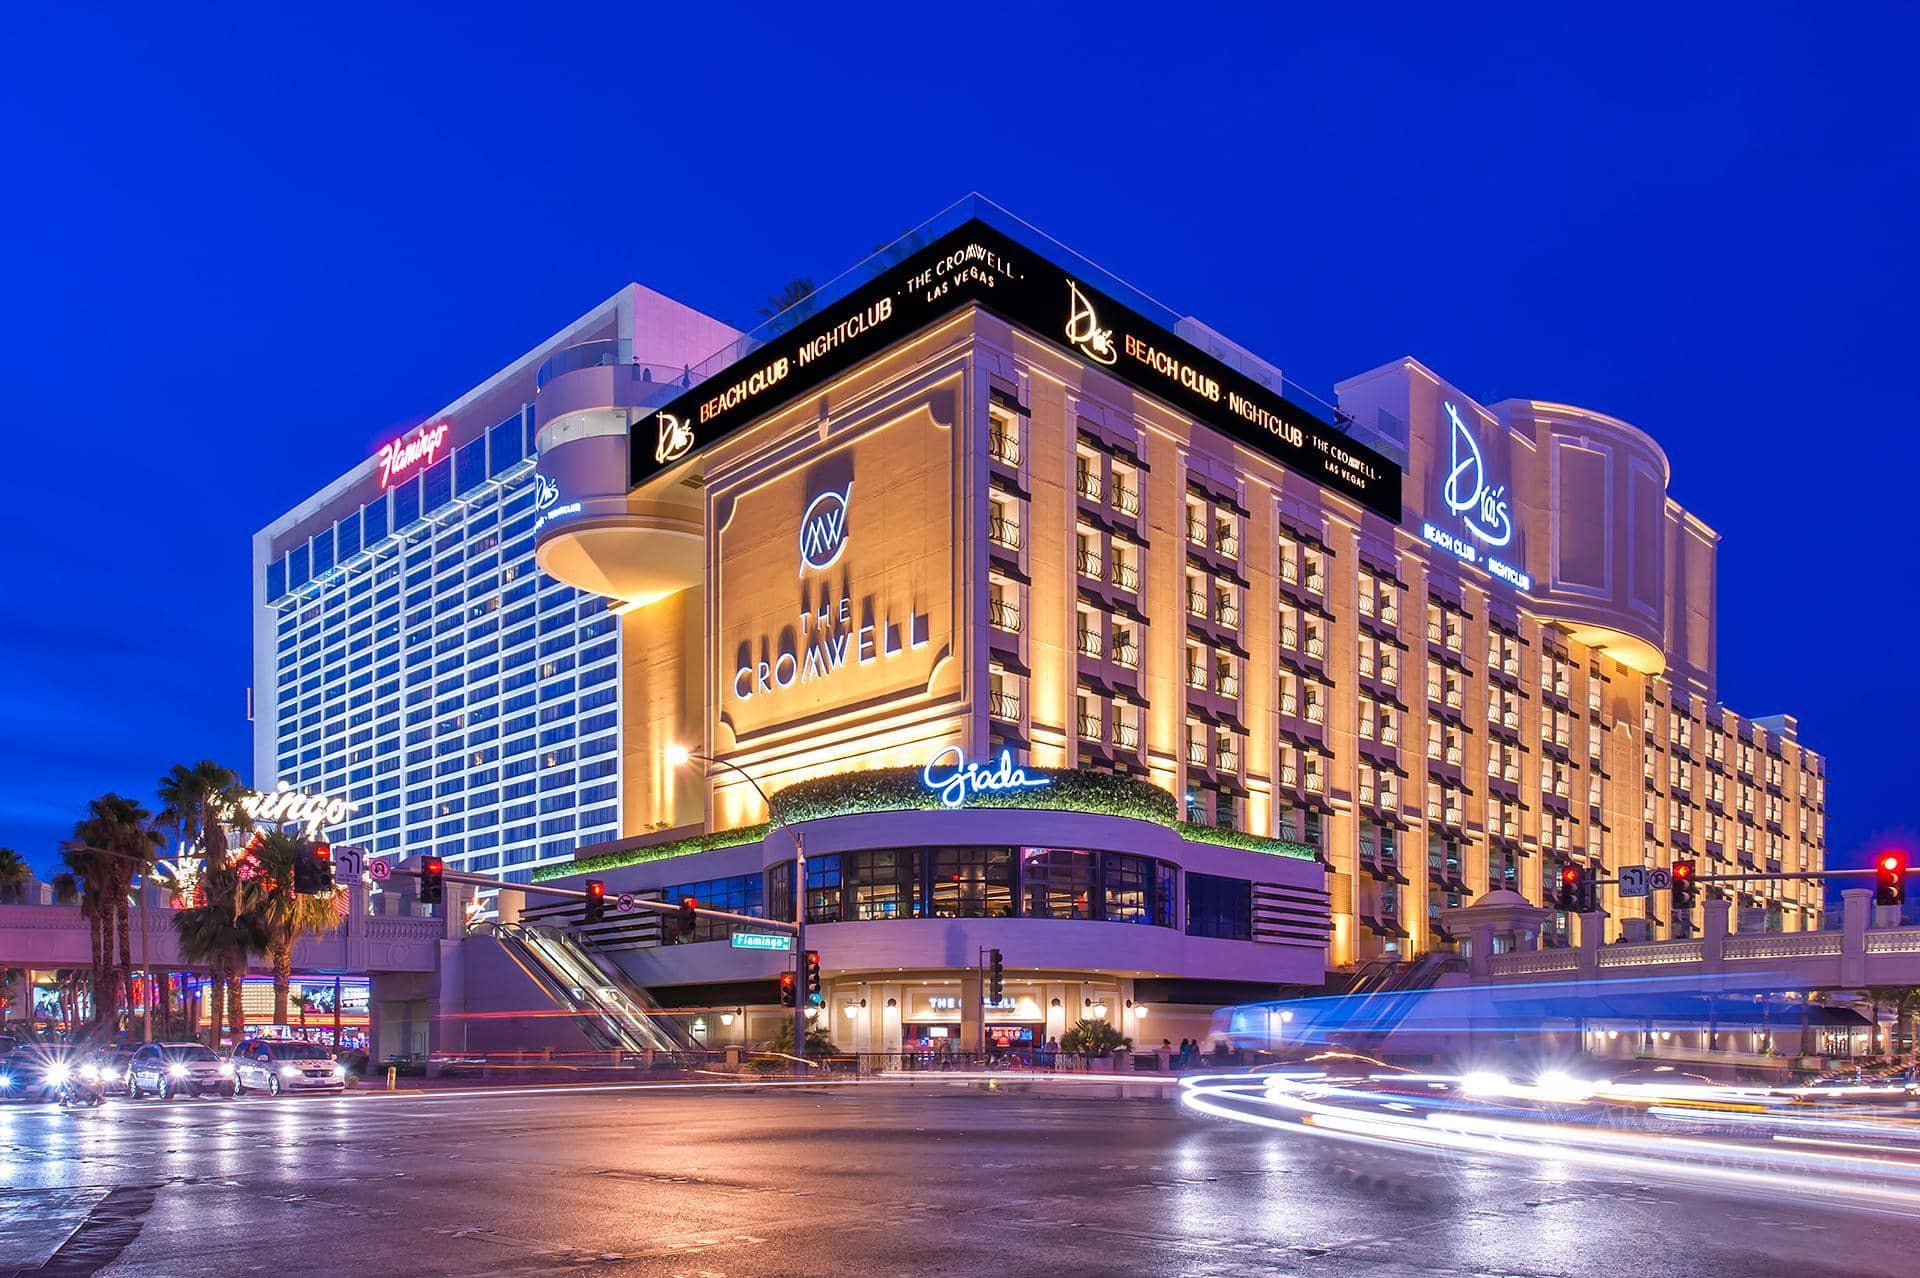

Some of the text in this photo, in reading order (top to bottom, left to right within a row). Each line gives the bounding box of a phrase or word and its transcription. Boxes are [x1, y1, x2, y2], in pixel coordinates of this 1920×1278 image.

[906, 243, 1015, 293] THE CROMWELL
[926, 266, 995, 303] LAS VEGAS
[700, 296, 893, 424] BEACH CLUB NIGHTCLUB
[1125, 333, 1303, 448] BEACH CLUB NIGHTCLUB
[379, 424, 448, 489] Flamingo
[1312, 435, 1376, 481] THE CROMWELL
[1324, 460, 1366, 489] LAS VEGAS
[1444, 401, 1511, 547] Drai's
[1423, 523, 1530, 591] BEACH CLUB NIGHTCLUB
[799, 597, 851, 635] THE
[733, 611, 930, 701] CROMWELL
[923, 744, 1049, 807] Giada
[1622, 887, 1642, 895] ONLY
[737, 934, 783, 949] Flamingo
[928, 997, 956, 1009] THE
